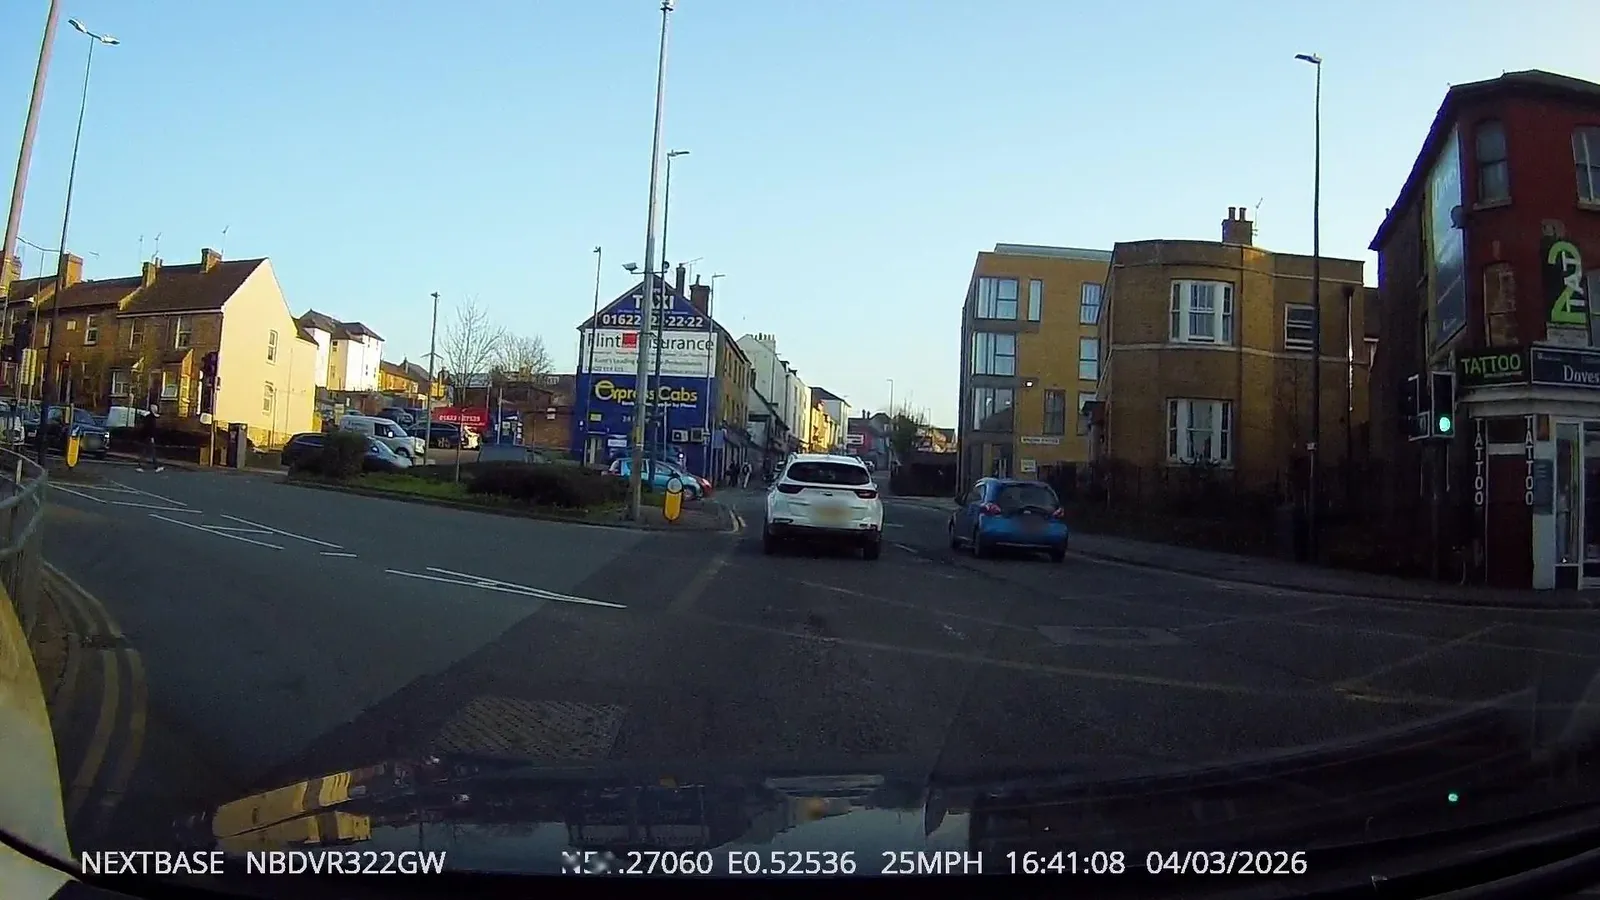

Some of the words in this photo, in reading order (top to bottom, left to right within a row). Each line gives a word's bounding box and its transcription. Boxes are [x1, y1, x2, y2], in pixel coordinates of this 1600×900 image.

[632, 294, 675, 310] TXI
[602, 314, 641, 325] 01622
[1461, 354, 1521, 375] TATTOO
[658, 386, 698, 402] Cabs
[1475, 418, 1483, 505] TATTOO
[1525, 415, 1534, 505] TATTOO
